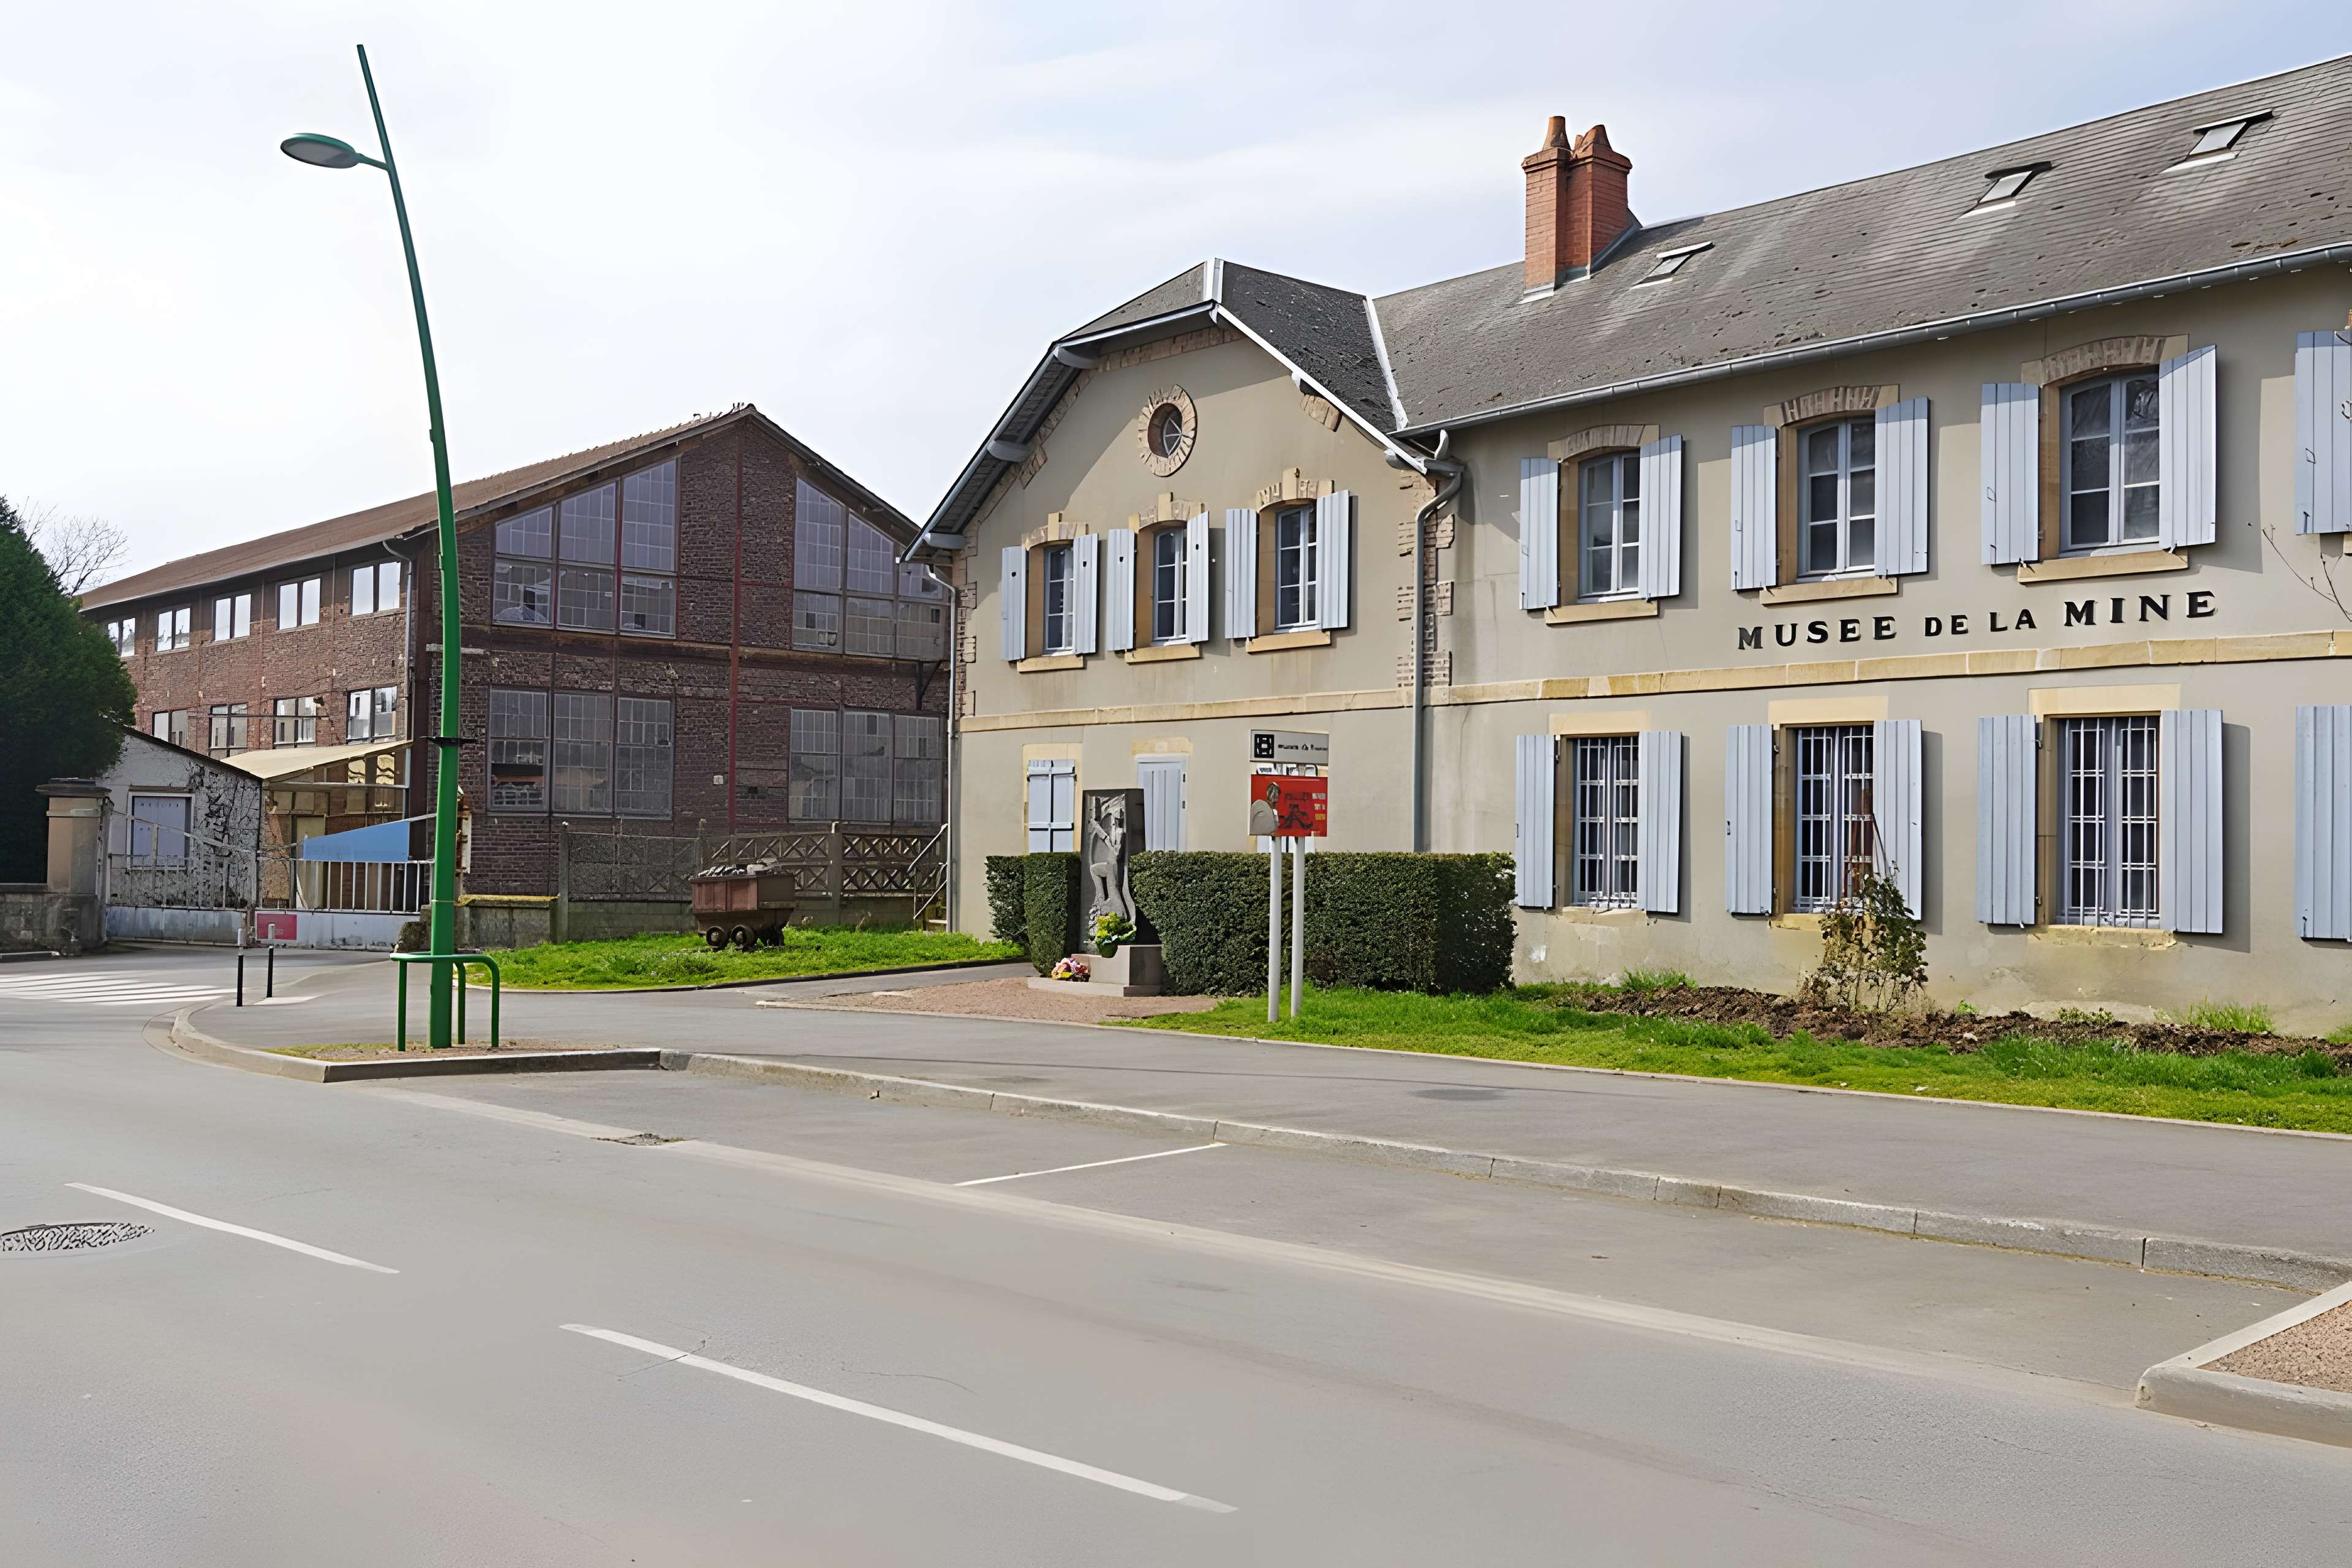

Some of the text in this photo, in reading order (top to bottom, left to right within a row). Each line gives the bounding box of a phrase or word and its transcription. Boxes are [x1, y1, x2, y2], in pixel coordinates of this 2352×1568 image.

[1737, 590, 2217, 650] MUSEE DE LA MINE
